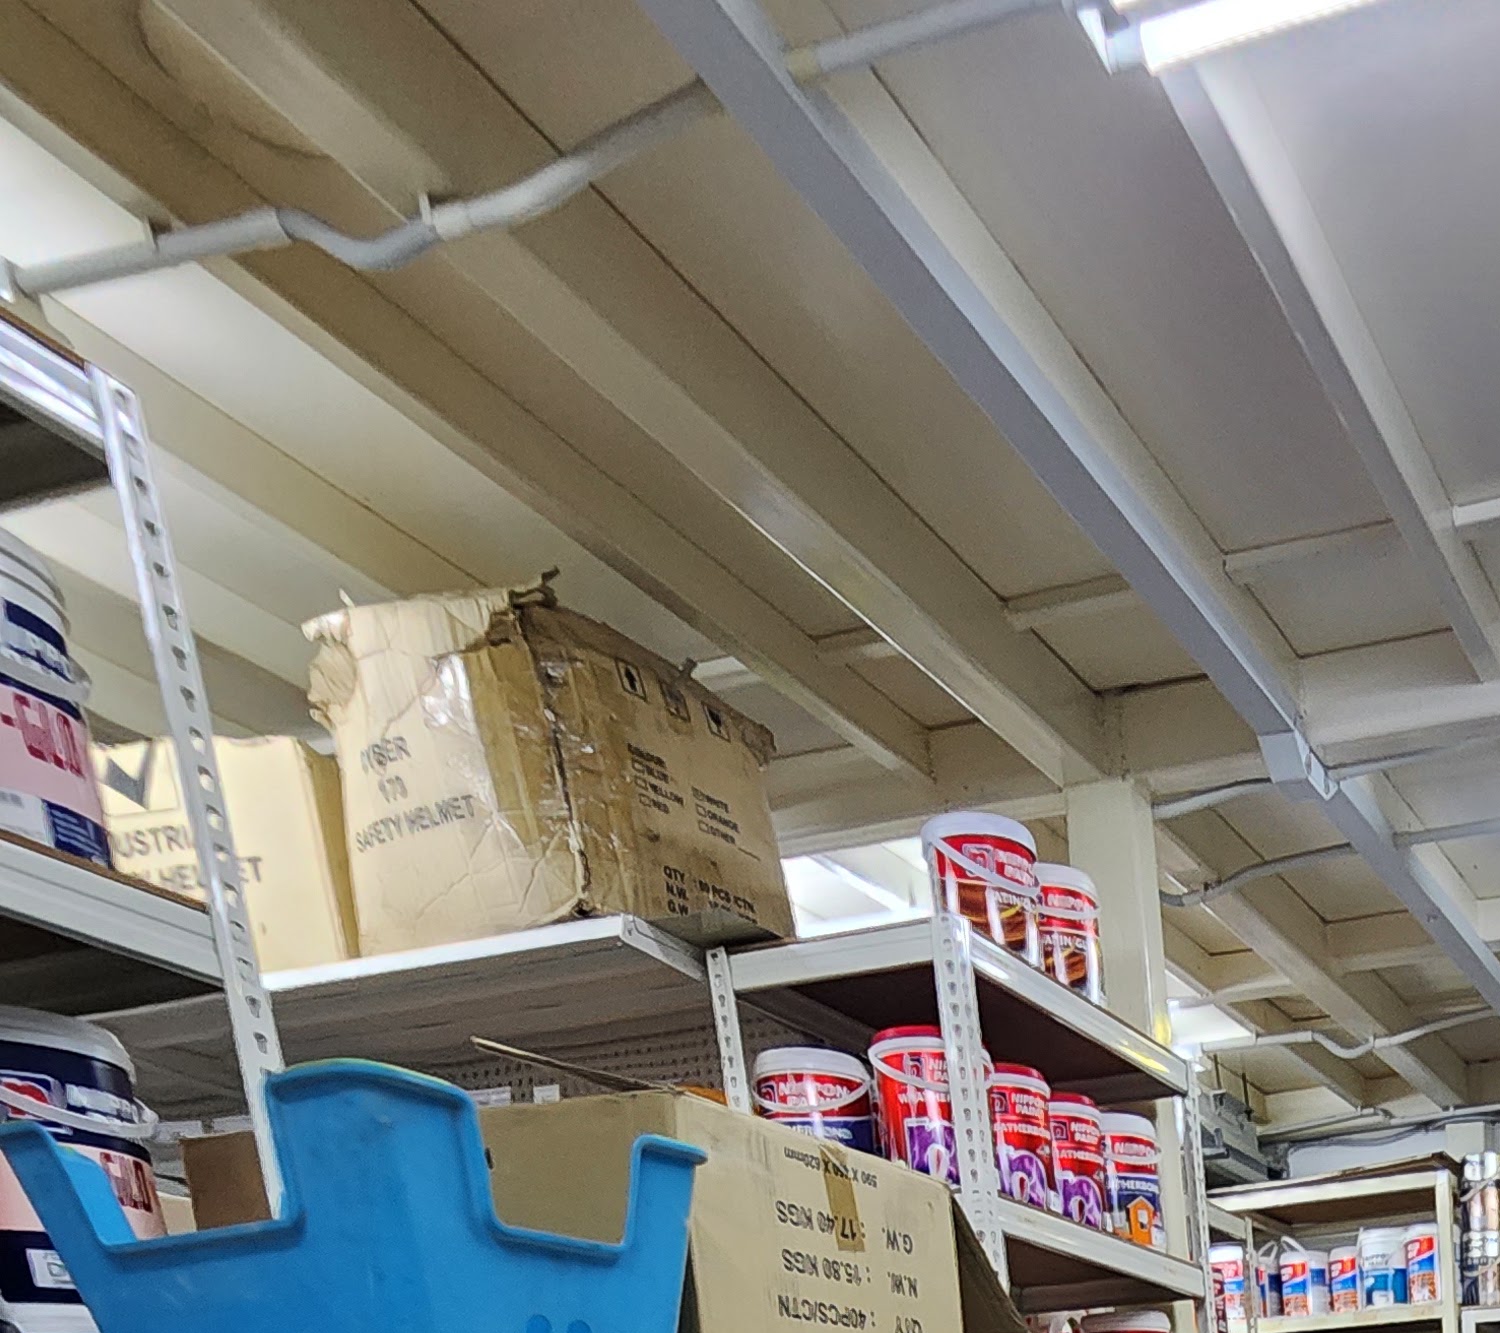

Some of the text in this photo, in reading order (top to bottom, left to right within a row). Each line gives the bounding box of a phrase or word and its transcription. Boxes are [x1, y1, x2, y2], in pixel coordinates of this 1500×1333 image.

[0, 693, 85, 778] -GLO
[776, 1199, 814, 1226] KGS
[782, 1247, 819, 1274] KGS
